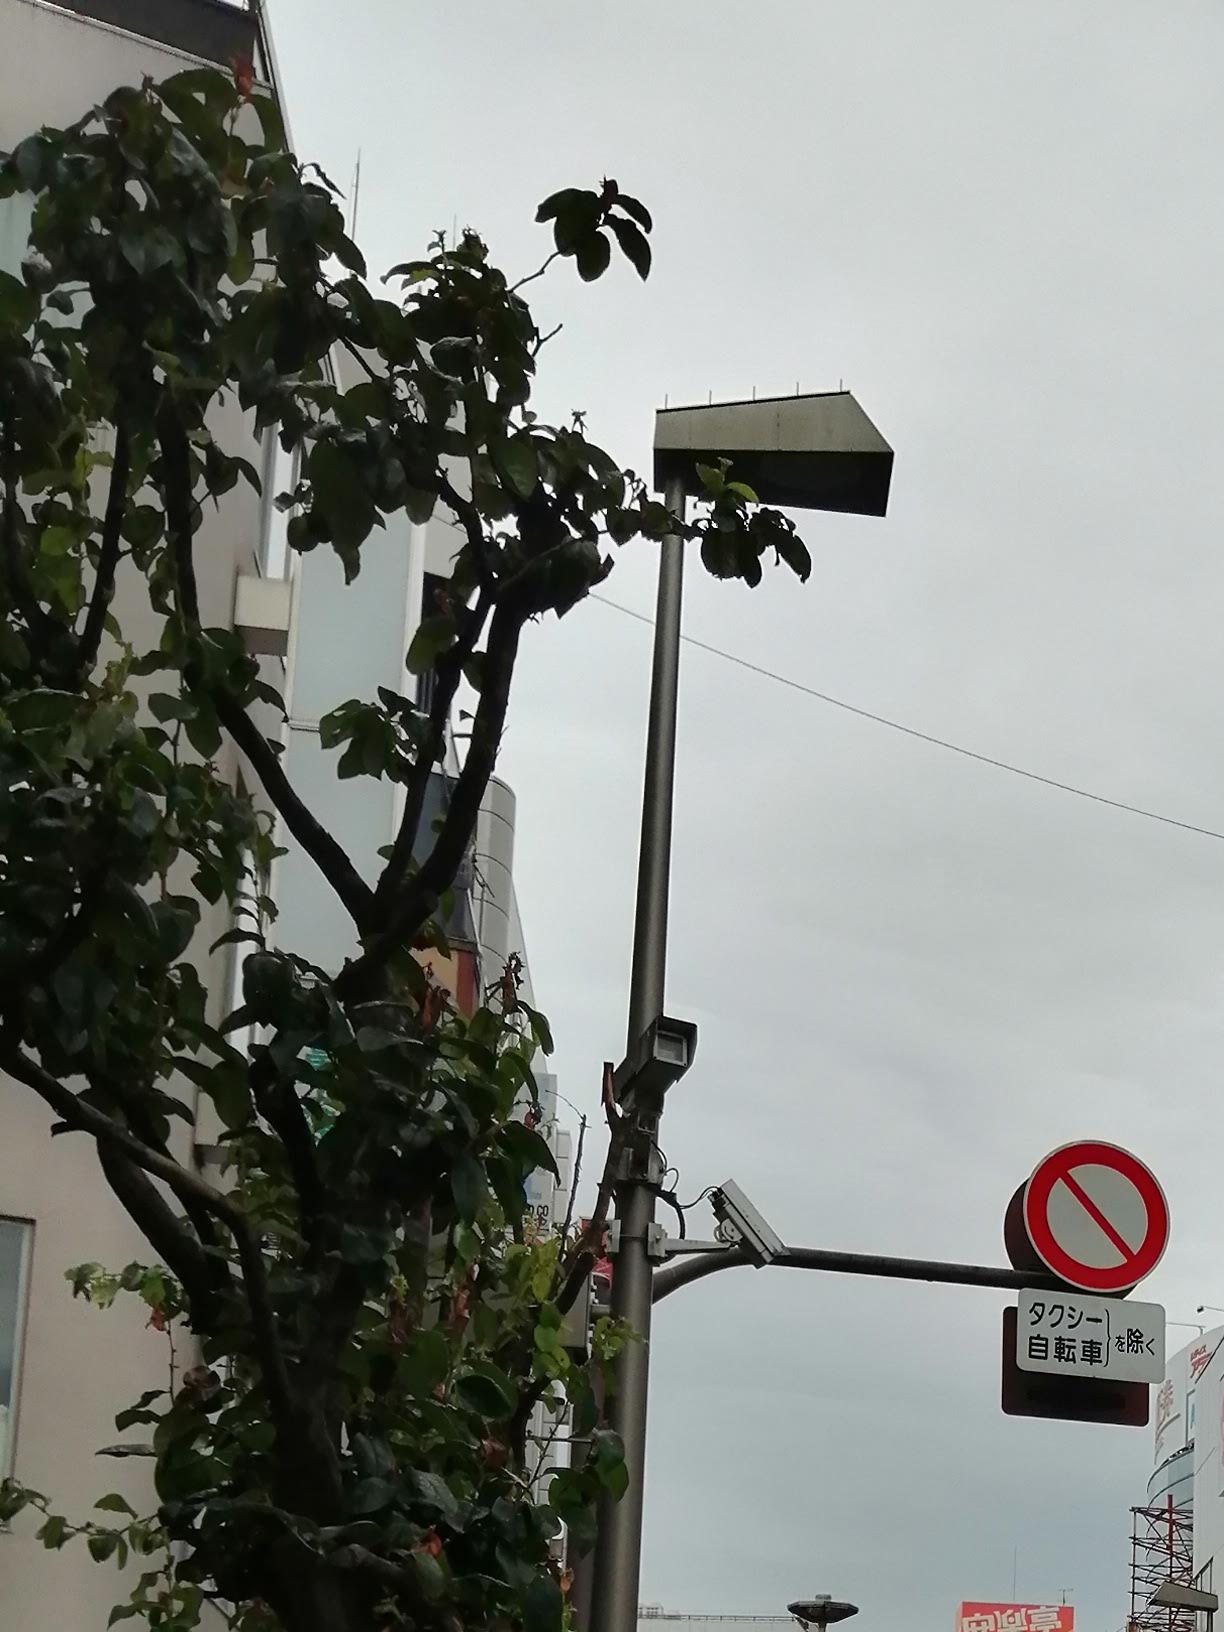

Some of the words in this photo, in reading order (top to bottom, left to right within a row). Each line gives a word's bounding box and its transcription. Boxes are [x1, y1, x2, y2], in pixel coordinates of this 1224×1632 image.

[1029, 1302, 1103, 1329] タクシー
[1028, 1334, 1103, 1365] 自転車
[1115, 1328, 1155, 1356] を除く
